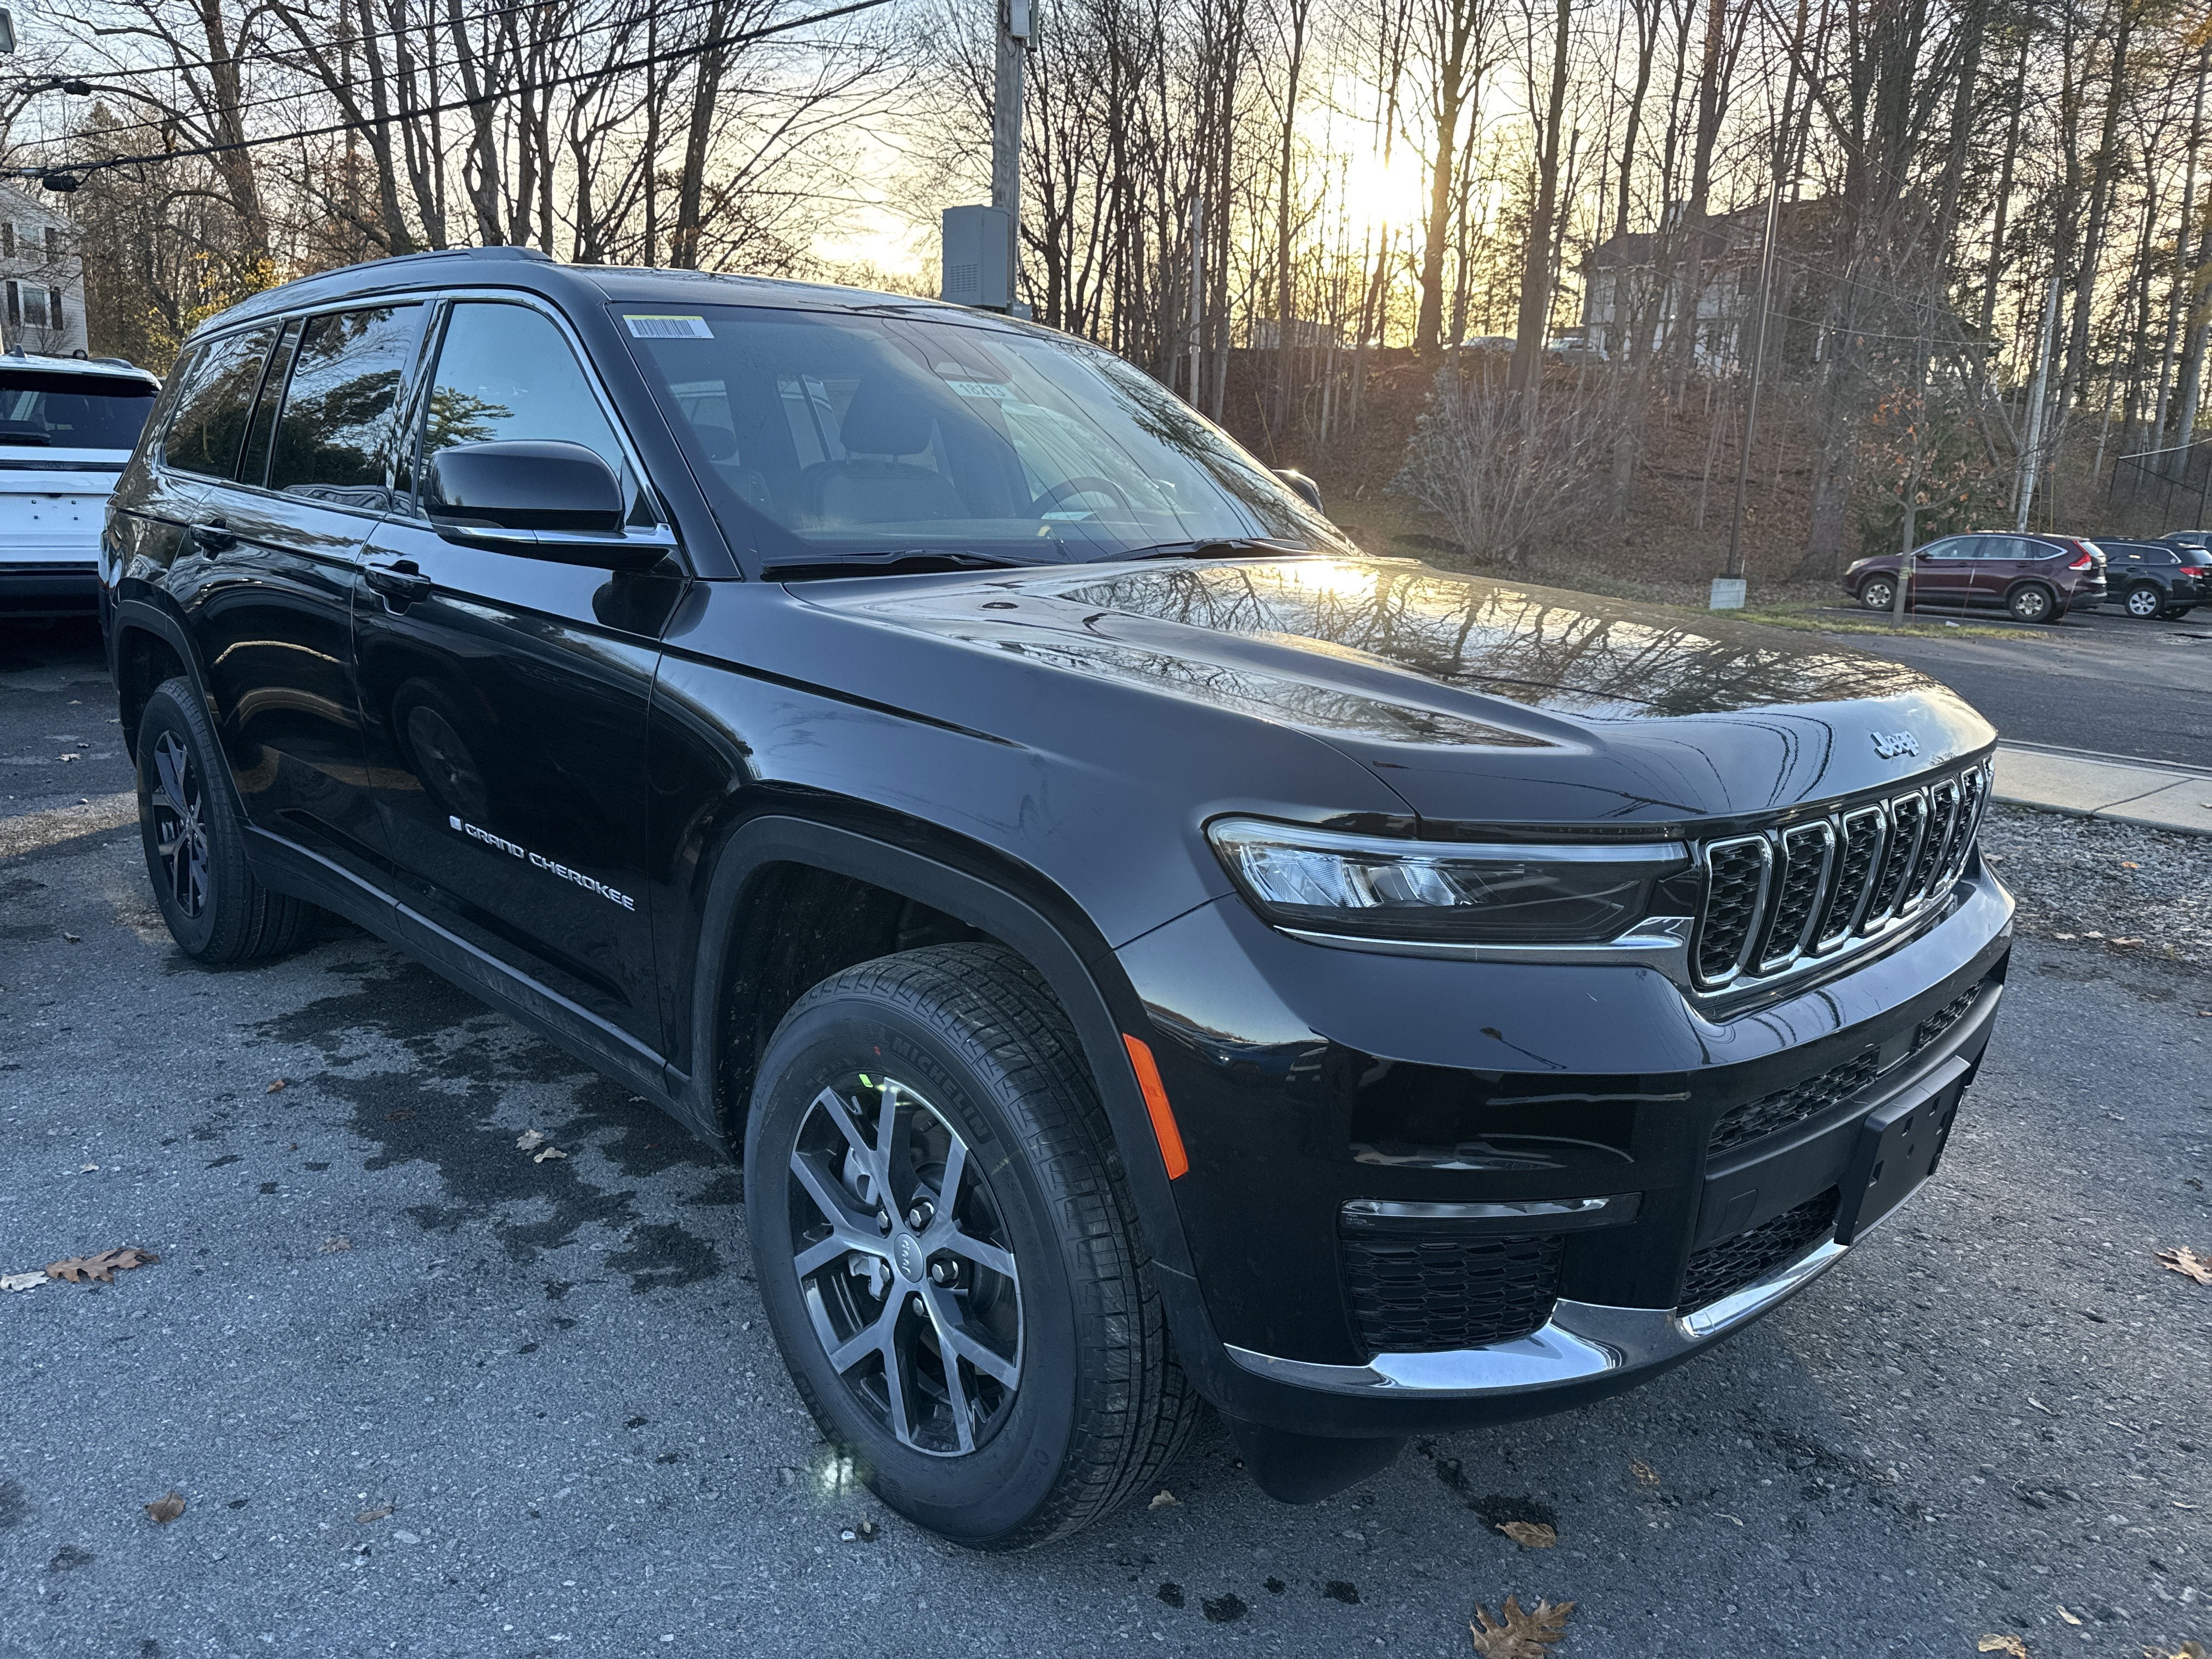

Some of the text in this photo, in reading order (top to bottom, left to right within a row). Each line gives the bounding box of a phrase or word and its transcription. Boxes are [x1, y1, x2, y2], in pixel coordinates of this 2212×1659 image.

[959, 383, 1006, 397] 18213
[1870, 731, 1920, 759] Jeep
[464, 822, 636, 912] GRAND CHEROKEE
[892, 1036, 989, 1137] MICHELIN
[901, 1239, 911, 1276] Jeep
